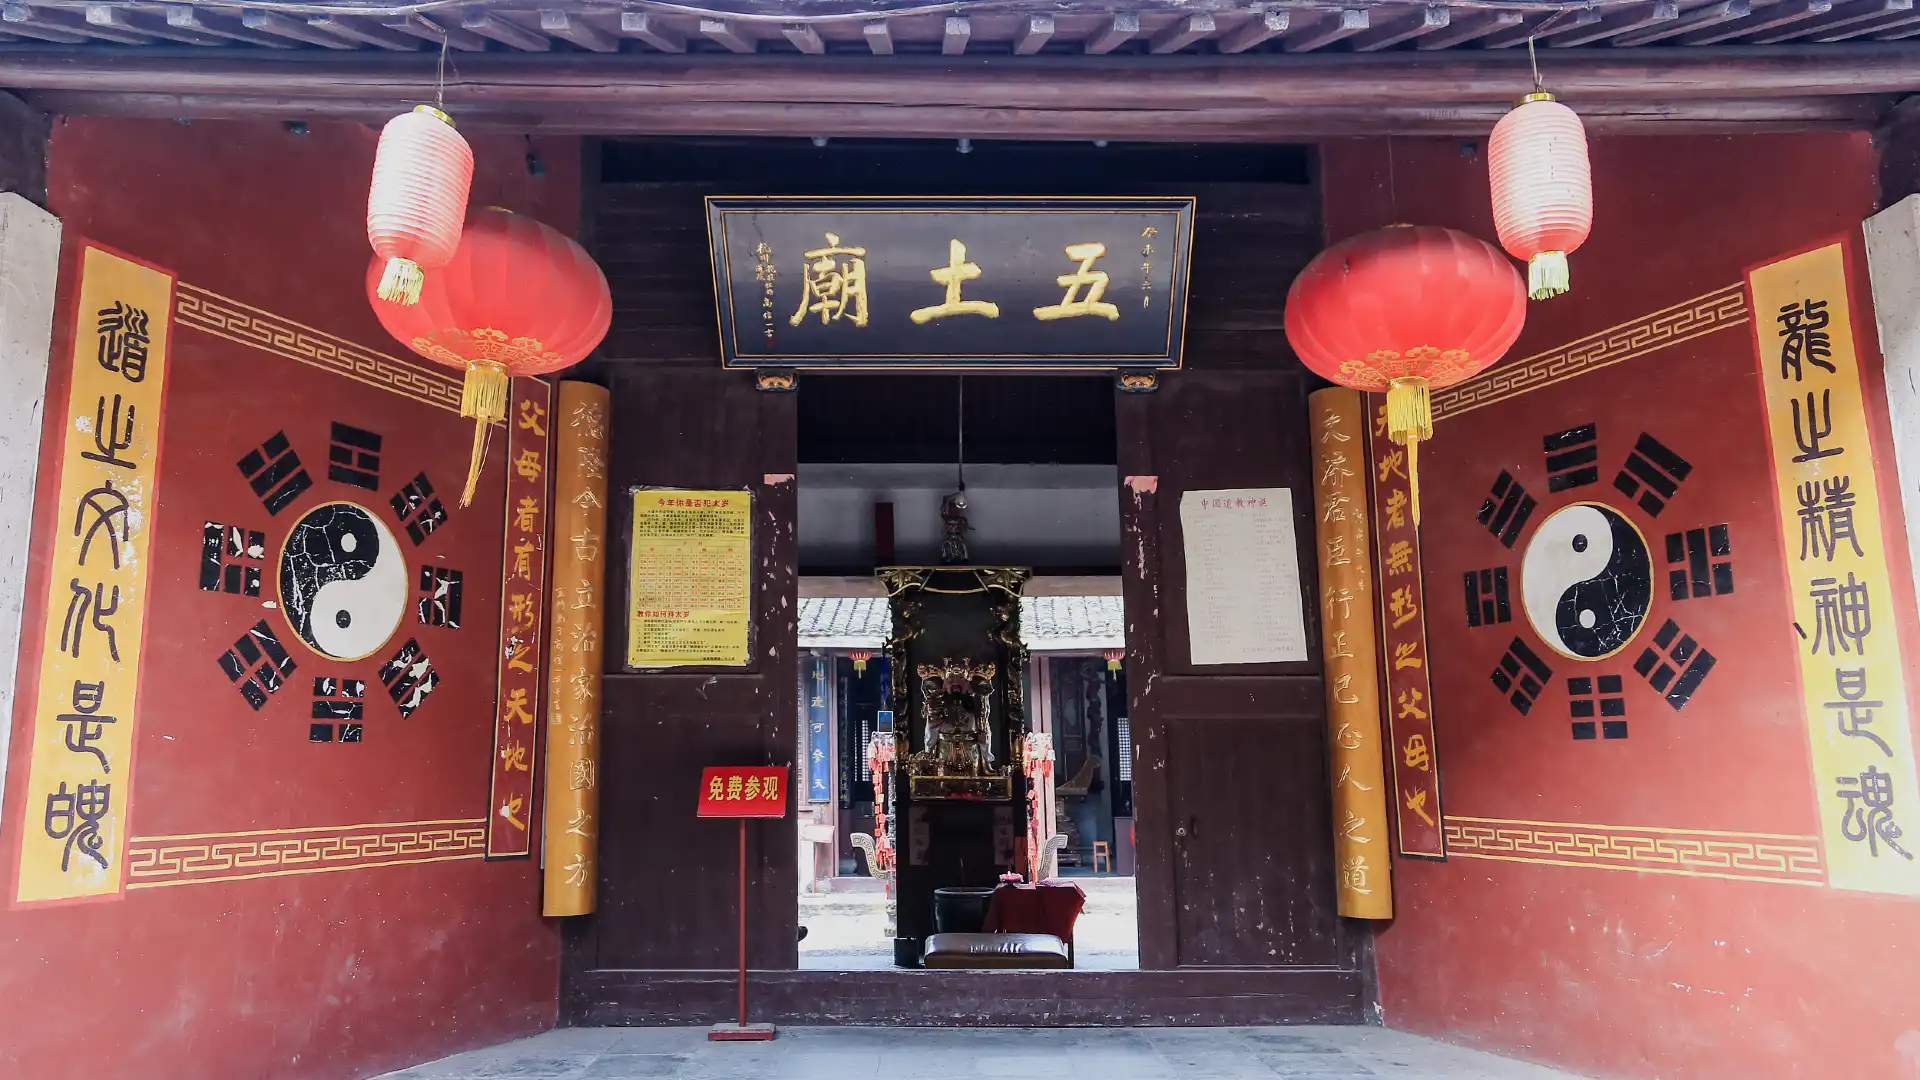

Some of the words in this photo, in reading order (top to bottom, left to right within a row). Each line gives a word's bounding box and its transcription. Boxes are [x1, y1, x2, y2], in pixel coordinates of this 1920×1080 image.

[789, 232, 1119, 328] 五土廟
[658, 498, 729, 508] 今年你是否犯太岁
[1201, 497, 1268, 509] 中国道教神诞
[1777, 299, 1913, 861] 龍之精神是魂
[498, 400, 546, 832] 父母者有形之天地也
[637, 610, 690, 618] 教你如何拜太岁
[708, 775, 779, 801] 免费参观
